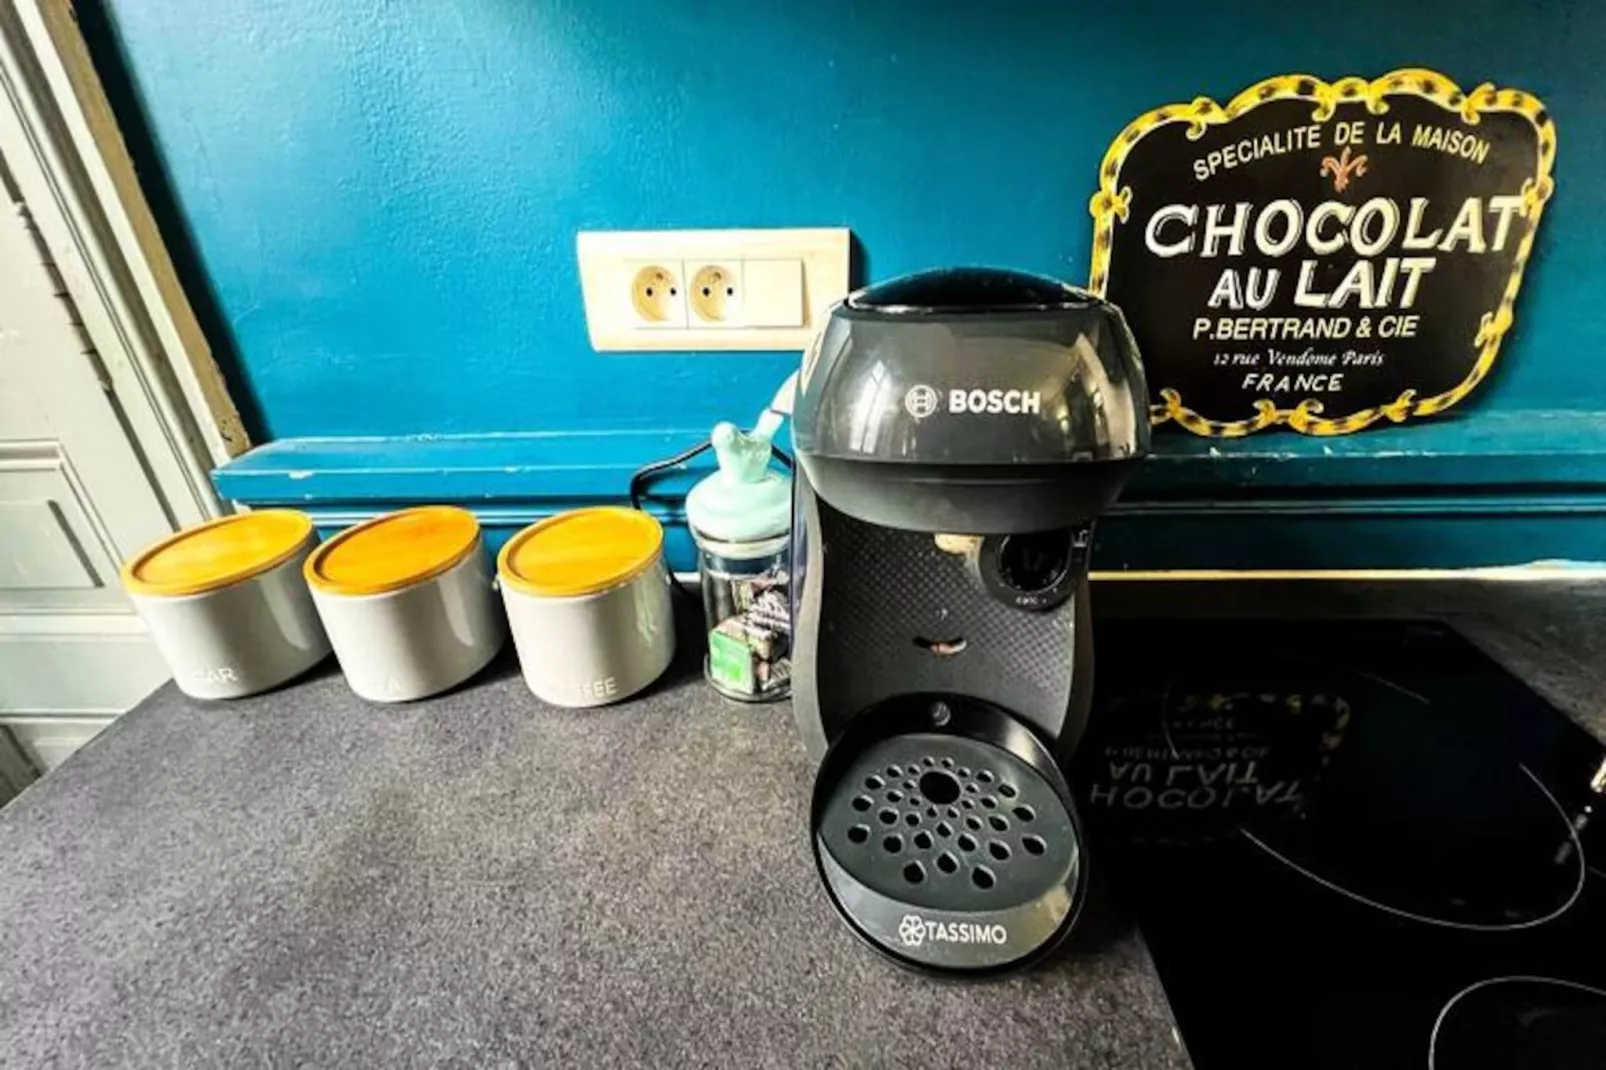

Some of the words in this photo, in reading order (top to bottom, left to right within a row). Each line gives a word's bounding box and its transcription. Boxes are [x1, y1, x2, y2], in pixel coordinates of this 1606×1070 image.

[1193, 124, 1321, 181] SPECIALITE
[1334, 121, 1366, 146] DE
[1376, 121, 1402, 145] LA
[1412, 123, 1491, 165] MAISON
[1144, 197, 1525, 258] CHOCOLAT
[1207, 266, 1281, 311] AU
[1293, 256, 1438, 310] LAIT
[1192, 316, 1352, 341] P.BERTRAND
[1355, 315, 1373, 339] &
[1377, 314, 1421, 339] CIE
[1213, 351, 1230, 366] 12
[1231, 352, 1261, 367] rue
[1341, 349, 1385, 367] Paris
[1241, 372, 1345, 393] FRANCE
[948, 388, 1041, 414] BOSCH
[924, 920, 1008, 945] TASSIMO
